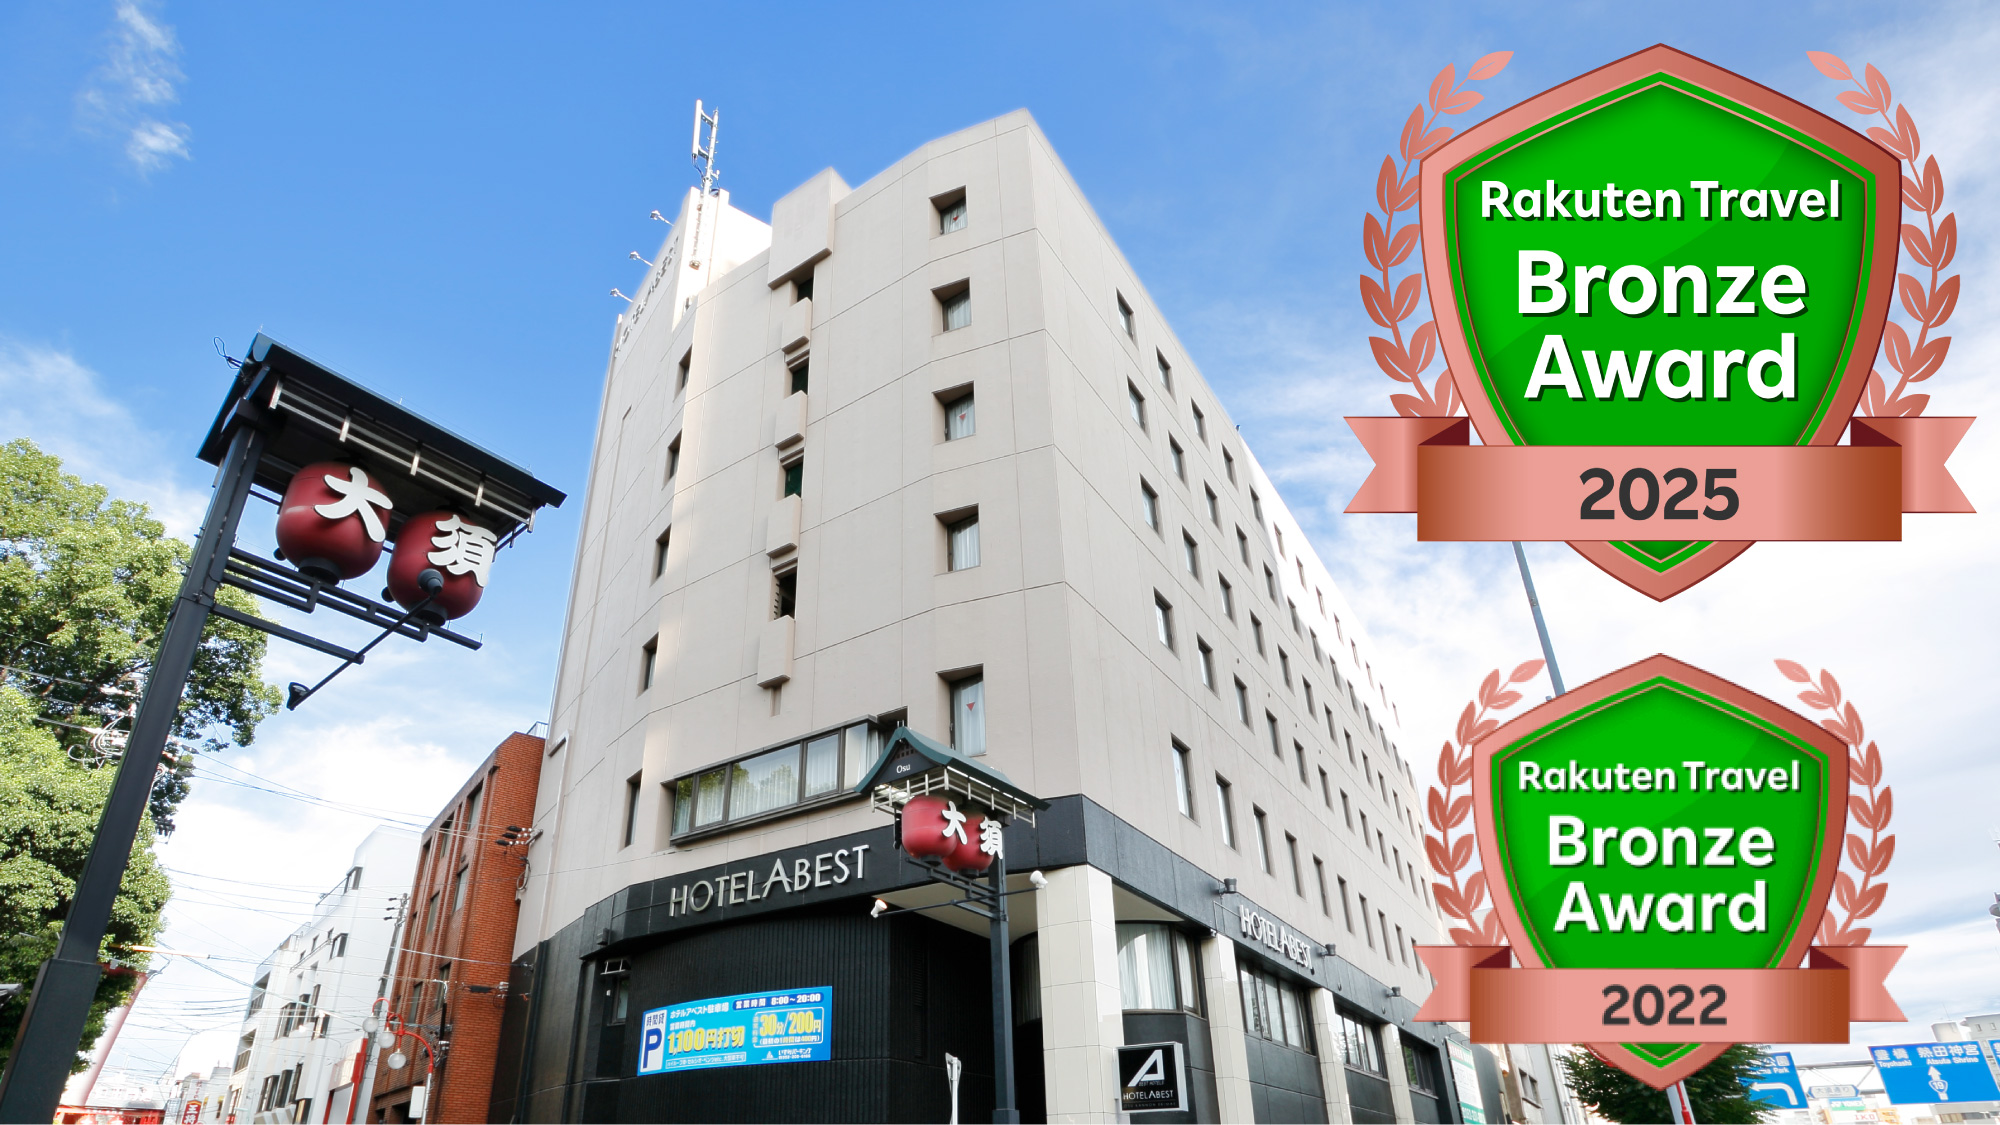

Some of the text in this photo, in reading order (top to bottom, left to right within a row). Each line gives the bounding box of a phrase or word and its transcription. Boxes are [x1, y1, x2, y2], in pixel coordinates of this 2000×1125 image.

[896, 763, 911, 774] Osu
[643, 1028, 662, 1069] P
[1916, 1044, 1980, 1058] 熱田神宮
[1877, 1060, 1912, 1068] Toyohashi
[1933, 1081, 1945, 1090] 19
